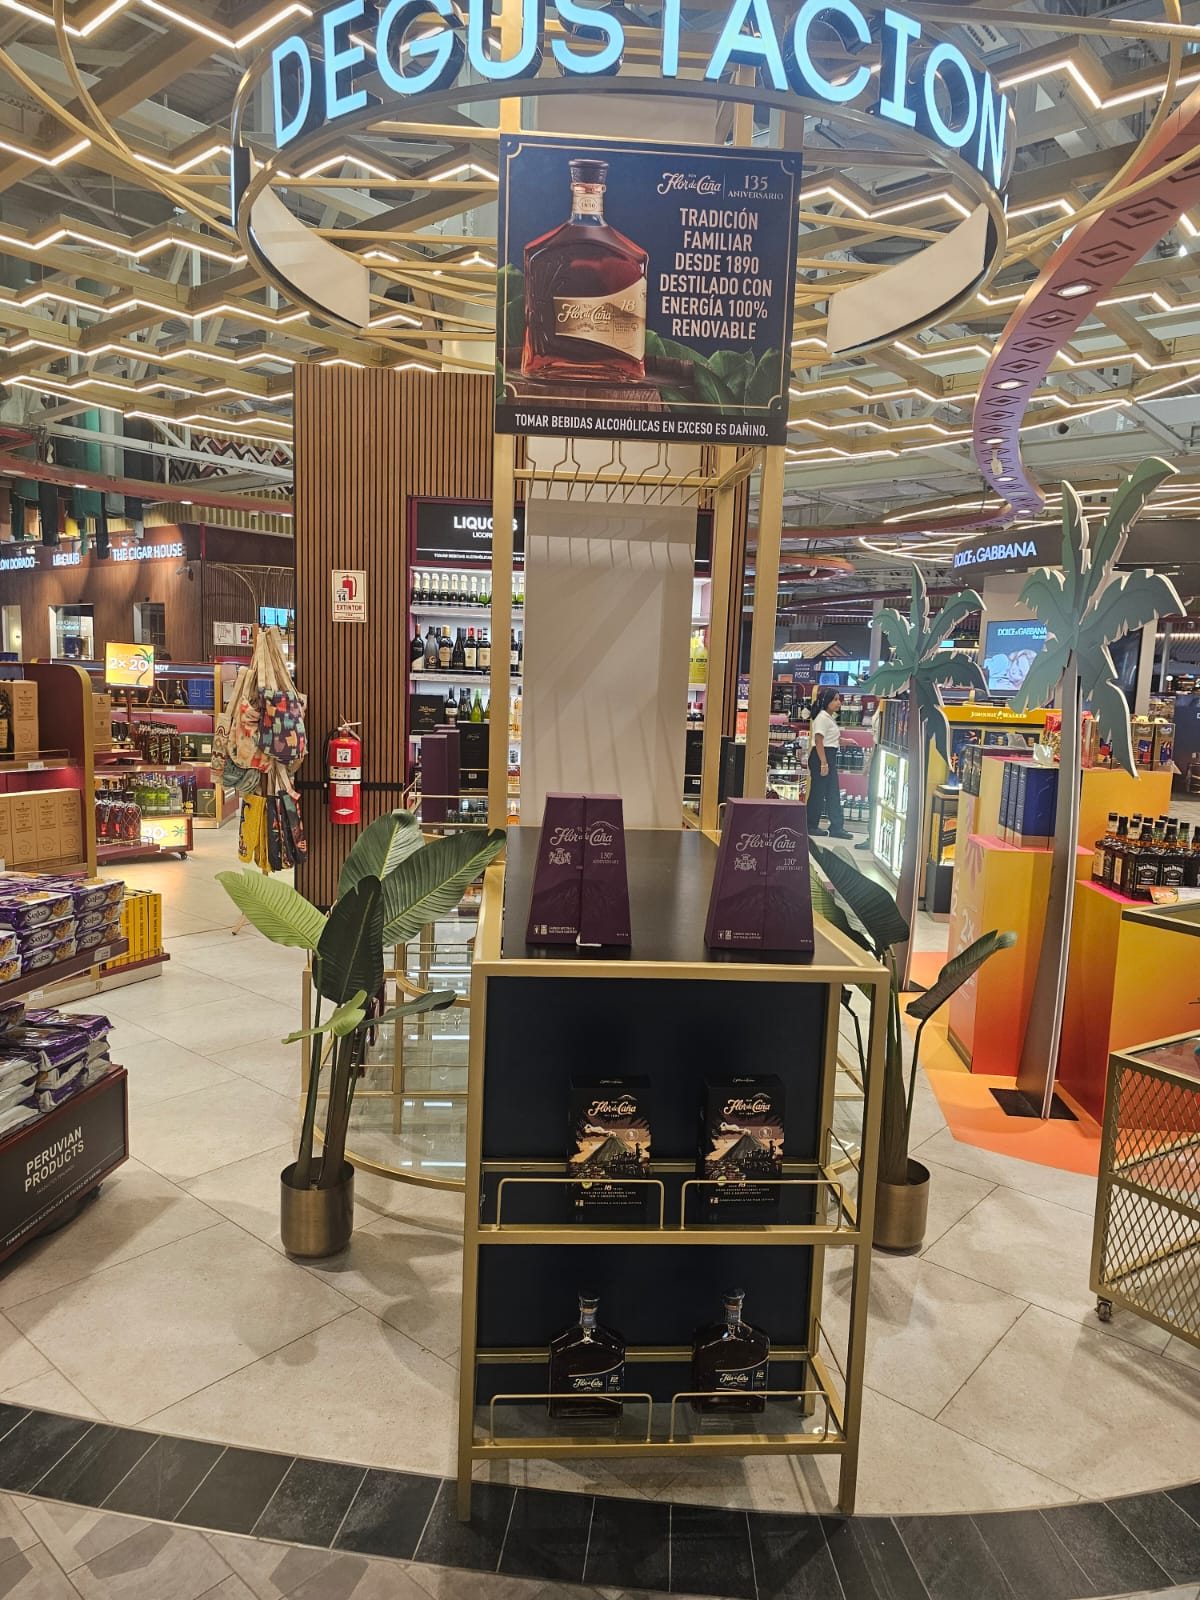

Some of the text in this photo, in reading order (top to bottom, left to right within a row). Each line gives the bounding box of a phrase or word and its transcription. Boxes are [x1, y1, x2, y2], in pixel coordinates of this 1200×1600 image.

[657, 172, 688, 194] Flor
[696, 176, 722, 195] Caña
[744, 176, 768, 191] 135
[728, 190, 784, 200] ANIVERSARIO
[680, 207, 758, 230] TRADICIÓN
[683, 230, 752, 252] FAMILIAR
[675, 252, 759, 274] DESDE 1890
[660, 274, 772, 297] DESTILADO CON
[661, 294, 768, 319] ENERGÍA 100%
[672, 318, 756, 340] RENOVABLE
[515, 413, 768, 438] TOMAR BEBIDAS ALCOHÓLICAS EN EXCESO ES DAÑINO.
[454, 516, 518, 531] LIQUS
[112, 544, 182, 562] THE CIGAR HOUSE
[338, 594, 346, 602] 14
[550, 828, 578, 846] Flor
[590, 828, 613, 846] Caña
[736, 834, 764, 852] Flor
[772, 834, 796, 852] Caña
[588, 1100, 612, 1116] Flor
[618, 1102, 636, 1115] Caña
[724, 1099, 746, 1114] Flor
[752, 1100, 771, 1112] Caña
[26, 1126, 82, 1176] PERUVIAN
[24, 1140, 84, 1192] PRODUCTS
